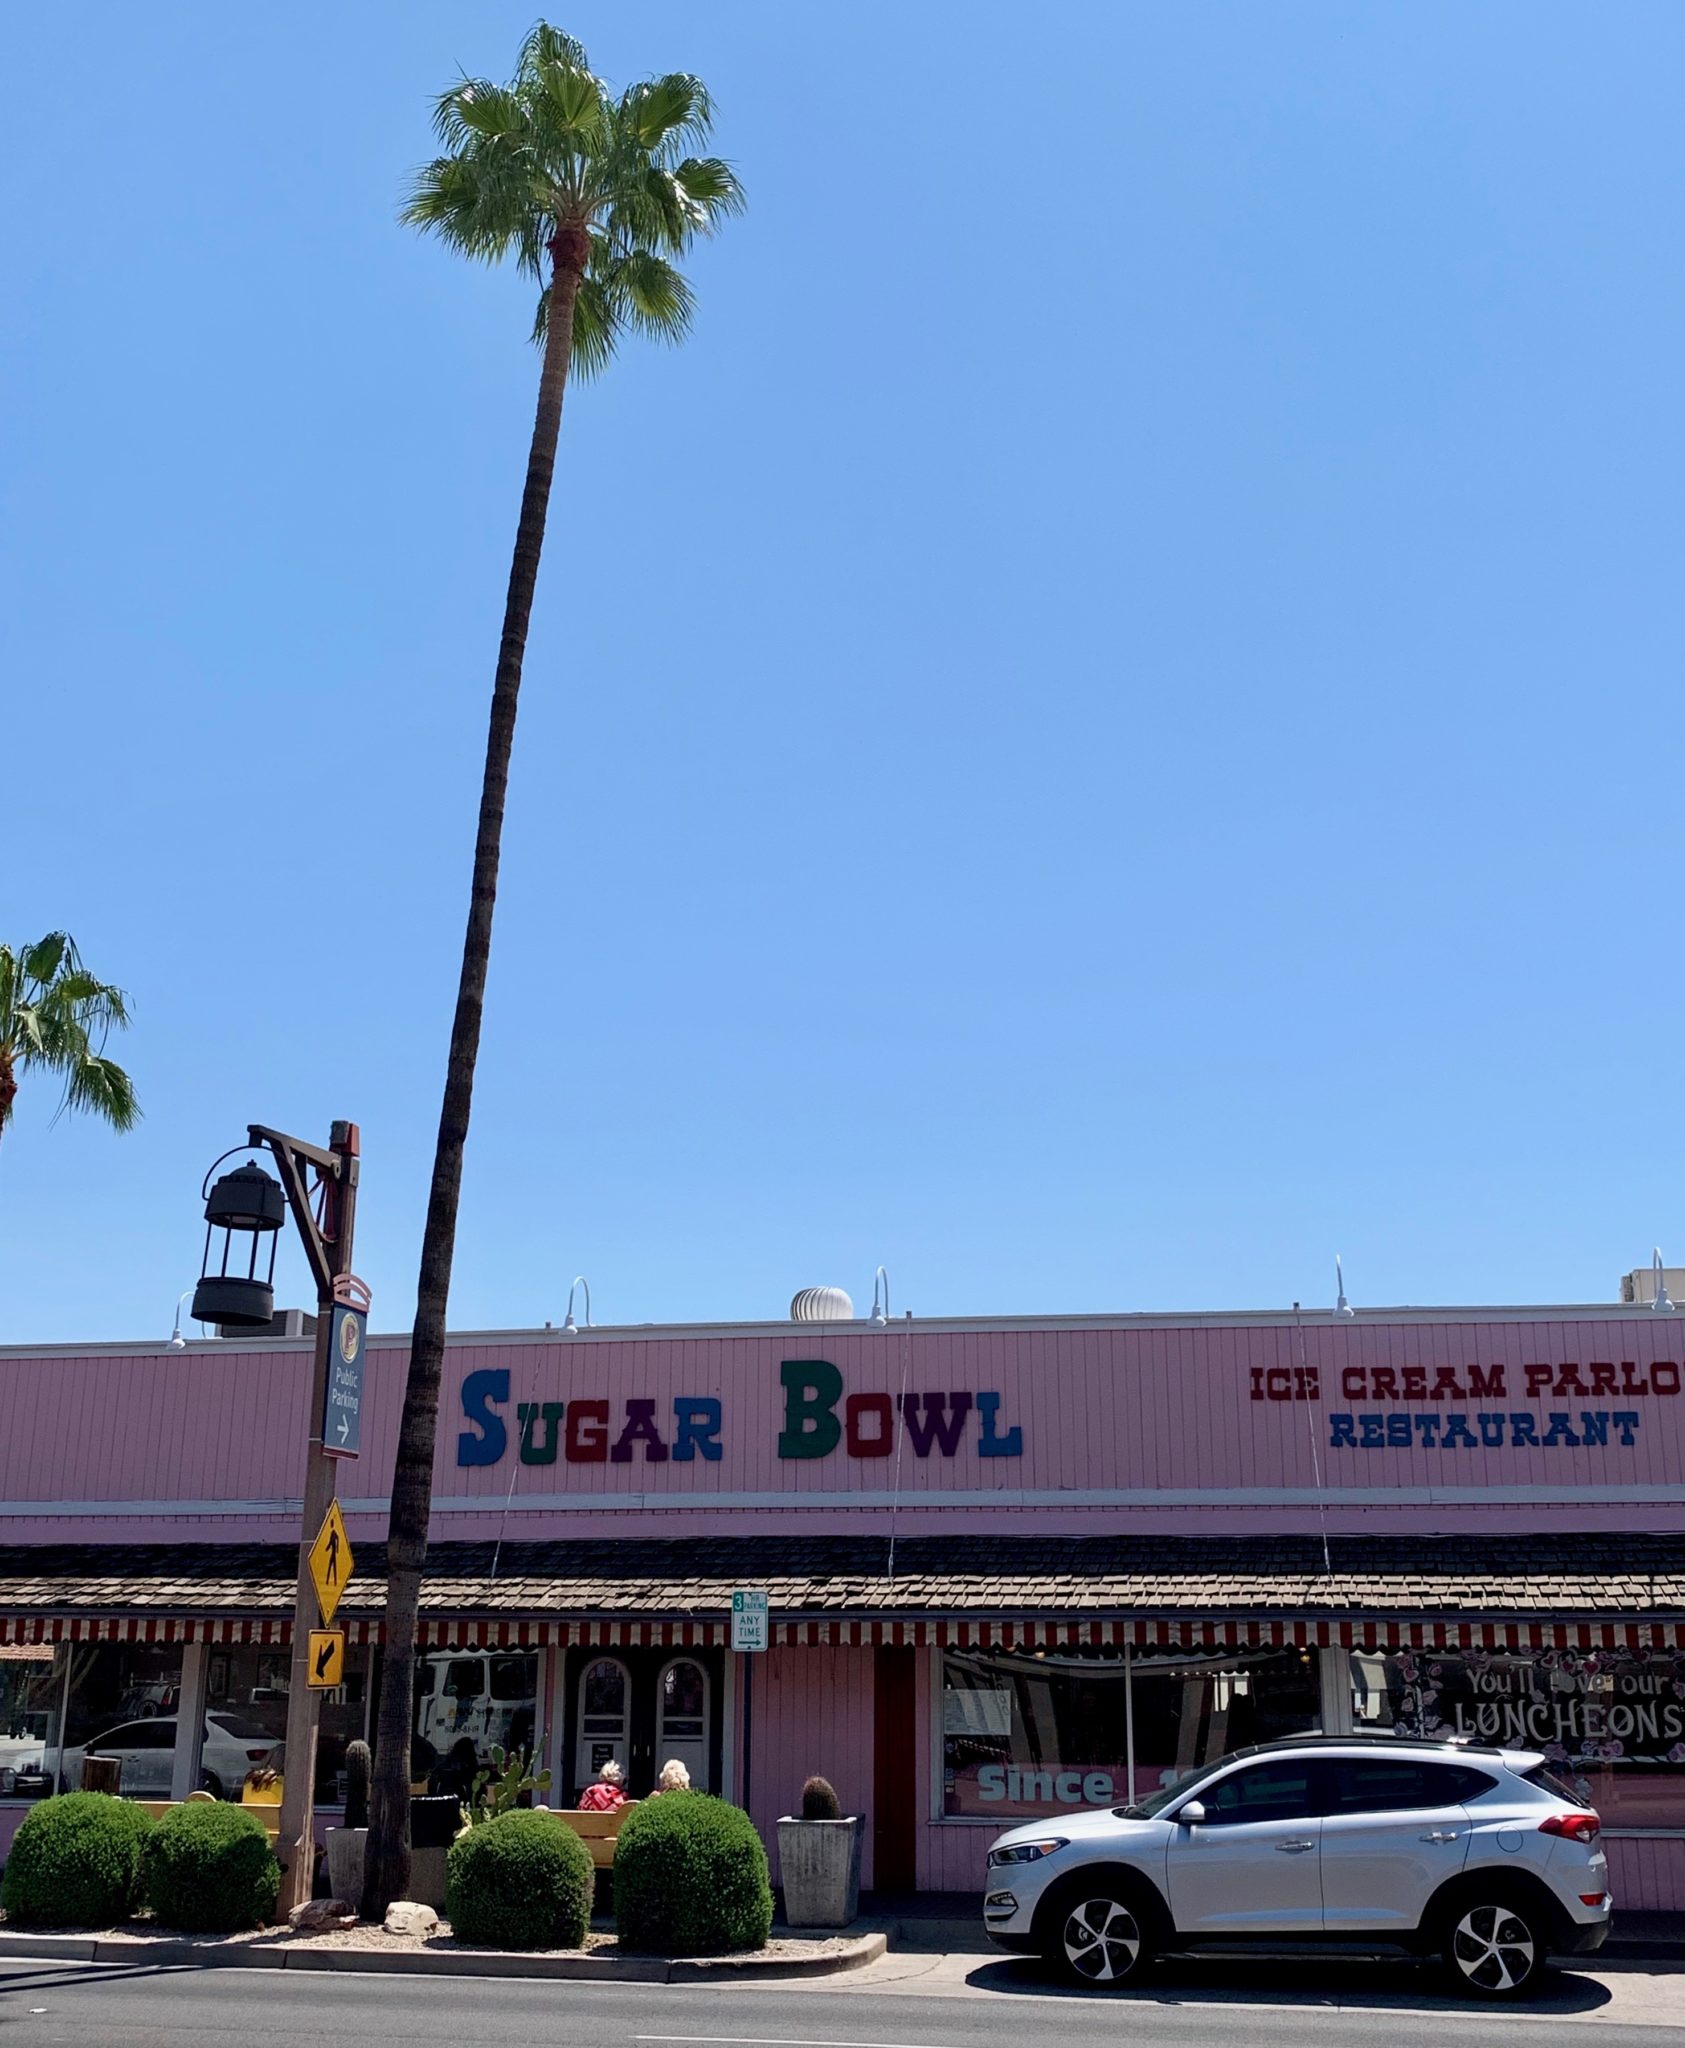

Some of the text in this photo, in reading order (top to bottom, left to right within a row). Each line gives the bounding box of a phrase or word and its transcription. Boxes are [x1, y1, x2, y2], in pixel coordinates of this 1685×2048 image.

[335, 1367, 358, 1388] Public
[1250, 1361, 1685, 1400] ICE CREAM PARLO
[332, 1388, 359, 1414] Parking
[458, 1360, 1023, 1467] SUGAR BOWL
[1329, 1411, 1640, 1448] RESTAURANT
[734, 1595, 743, 1610] 3
[739, 1615, 760, 1625] ANY
[739, 1627, 761, 1637] TIME
[1466, 1665, 1670, 1695] You'll ve our
[1454, 1699, 1683, 1744] LUNCHEONS
[977, 1764, 1114, 1805] Since
